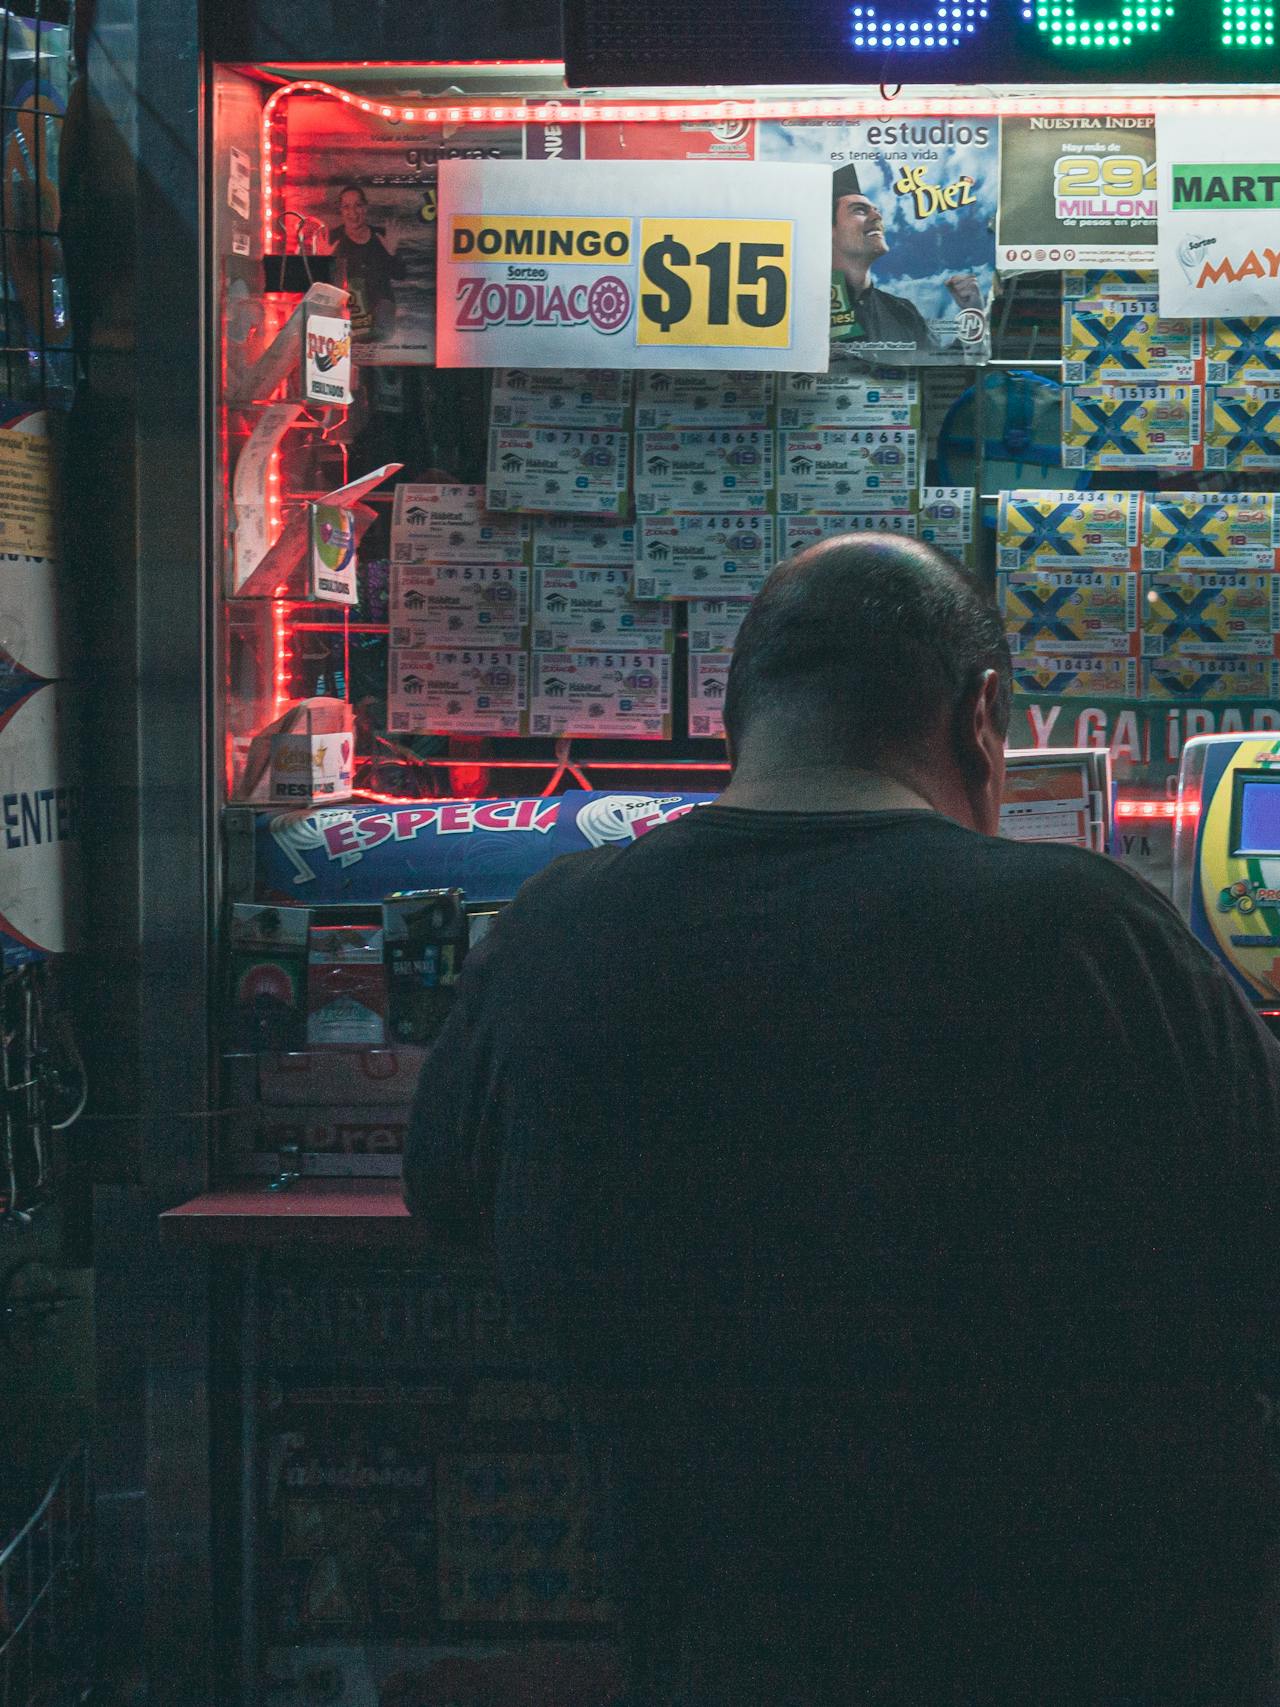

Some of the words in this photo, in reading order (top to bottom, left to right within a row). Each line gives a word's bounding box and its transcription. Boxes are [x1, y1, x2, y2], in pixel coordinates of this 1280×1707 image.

[1030, 117, 1101, 129] NUESTRA
[867, 119, 989, 146] estudios
[830, 151, 844, 161] es
[849, 151, 880, 161] tener
[883, 151, 907, 161] una
[912, 149, 938, 161] vida
[896, 164, 928, 196] de
[914, 175, 977, 219] Diez
[453, 229, 630, 257] DOMINGO
[507, 265, 548, 281] Sorteo
[641, 234, 788, 332] $15
[1120, 388, 1167, 399] 15131
[707, 432, 760, 444] 4865
[850, 431, 903, 444] 4865
[1058, 492, 1105, 502] 18434
[1201, 494, 1249, 504] 18434
[707, 517, 760, 530] 4865
[850, 517, 903, 530] 4865
[463, 567, 513, 581] 5151
[1056, 574, 1102, 585] 18434
[1200, 575, 1246, 586] 18434
[462, 653, 513, 666] 5151
[604, 655, 656, 669] 5151
[1056, 660, 1102, 671] 18434
[1028, 704, 1062, 749] Y
[625, 796, 683, 810] Sorteo
